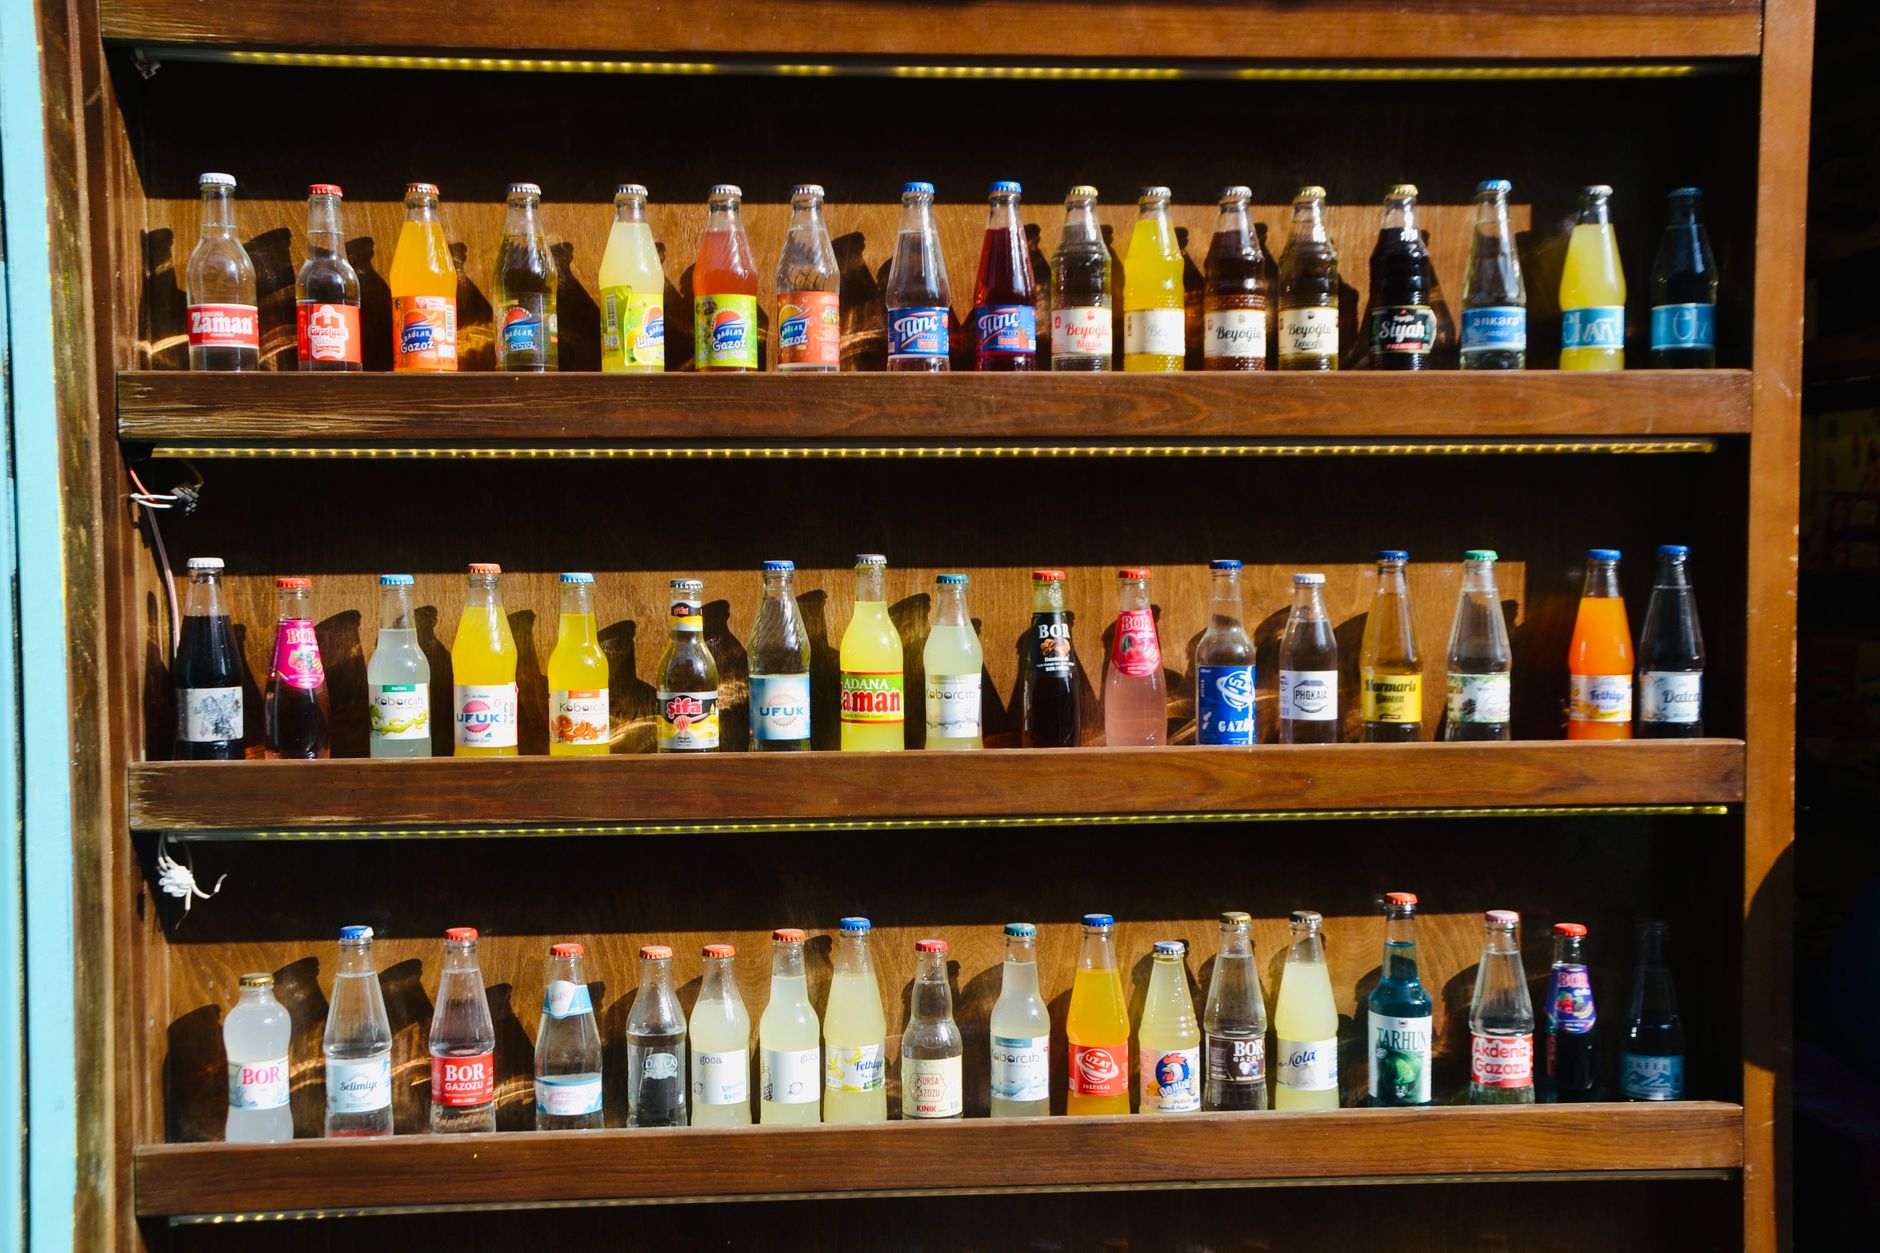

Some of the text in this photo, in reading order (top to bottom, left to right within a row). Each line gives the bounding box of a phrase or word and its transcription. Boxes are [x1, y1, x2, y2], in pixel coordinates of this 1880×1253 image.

[192, 312, 253, 335] Zaman
[1379, 320, 1425, 343] Siyah
[400, 341, 435, 354] Gazoz
[712, 339, 747, 352] Gazoz
[779, 335, 808, 349] Gazoz
[844, 678, 889, 690] ADANA
[841, 689, 902, 713] aman
[456, 713, 501, 723] UFUK
[759, 706, 805, 717] UFUK
[1376, 1028, 1427, 1050] TARHUN
[1233, 1039, 1264, 1058] BOR
[1474, 1041, 1528, 1059] Akdeniz
[241, 1066, 282, 1086] BOR
[445, 1063, 485, 1081] BOR
[445, 1081, 483, 1091] GAZOZU
[914, 1075, 939, 1087] BURSA
